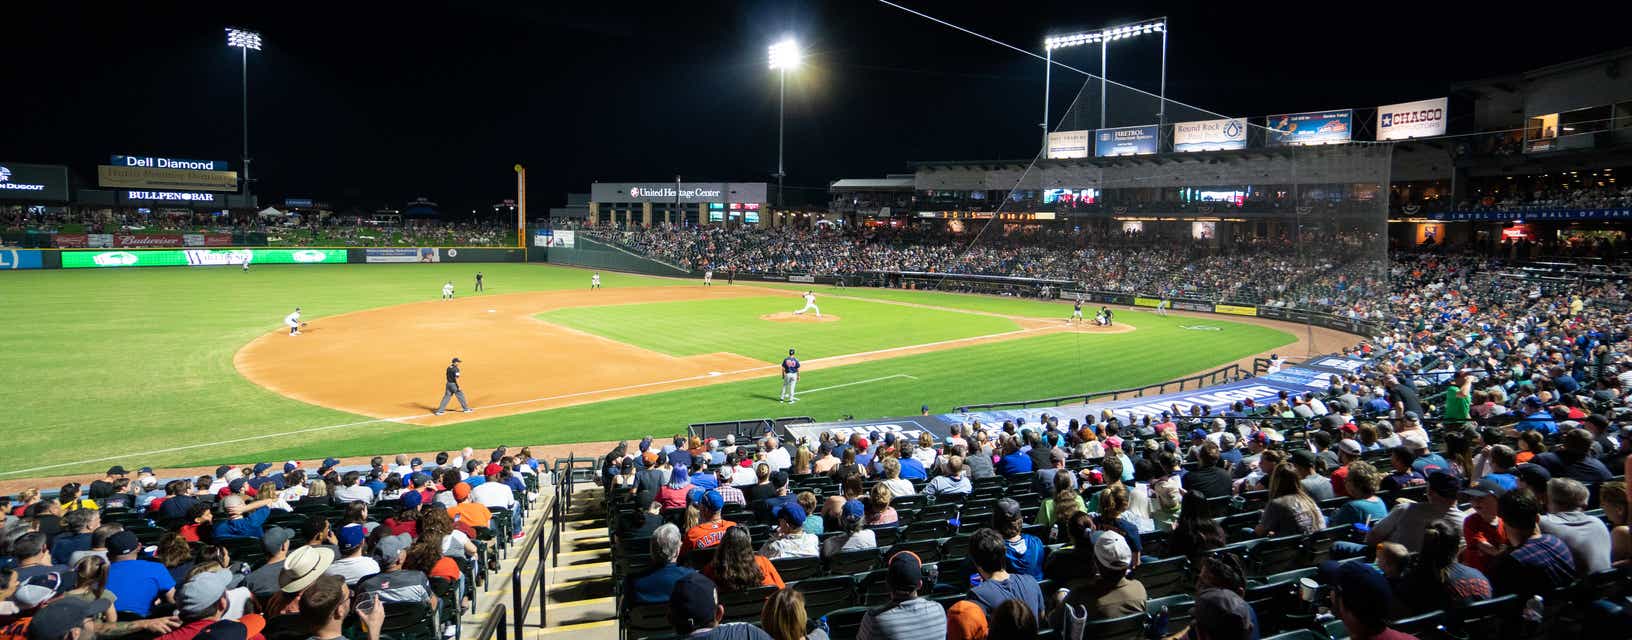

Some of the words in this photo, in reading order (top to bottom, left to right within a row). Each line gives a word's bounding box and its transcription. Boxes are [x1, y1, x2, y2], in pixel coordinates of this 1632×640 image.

[1393, 108, 1442, 125] CHASCO
[126, 156, 154, 167] Dell
[157, 158, 214, 170] Diamond
[7, 183, 45, 191] DUGOUT
[640, 187, 663, 197] United
[695, 187, 720, 198] Center
[128, 190, 182, 201] BULLPEN
[191, 193, 215, 201] BAR
[118, 235, 179, 246] Budweiser
[697, 530, 725, 549] ALTU
